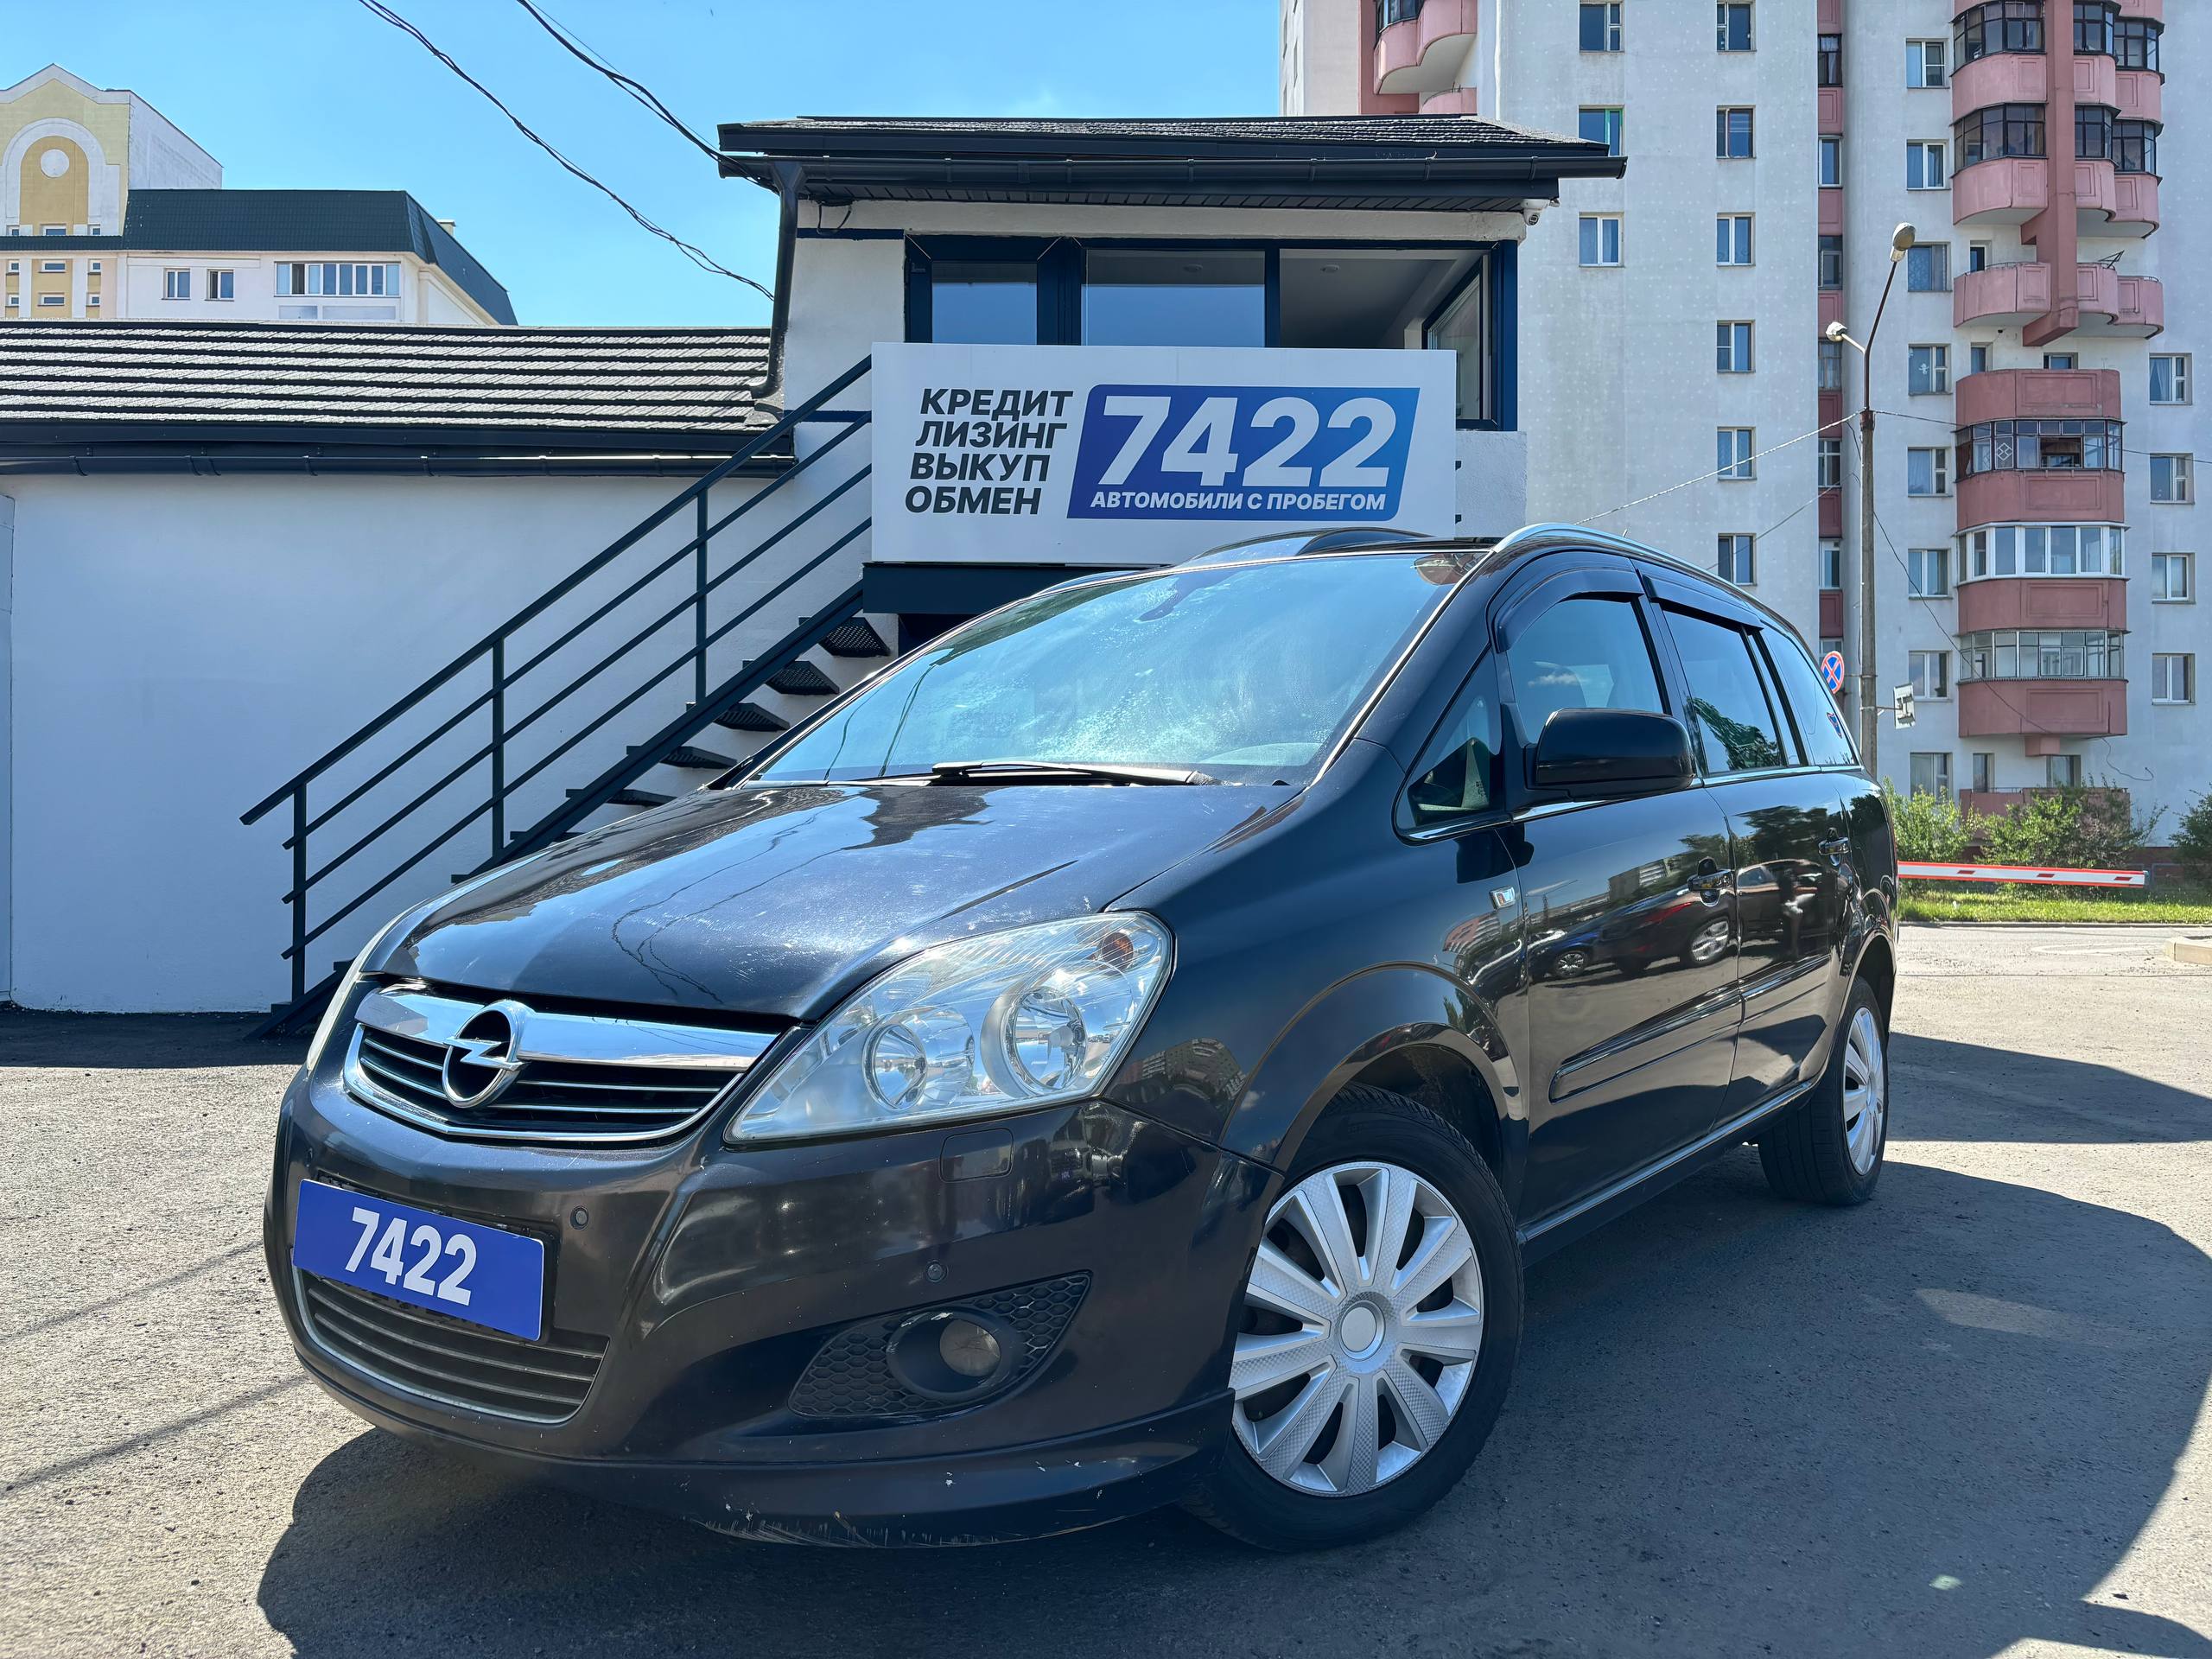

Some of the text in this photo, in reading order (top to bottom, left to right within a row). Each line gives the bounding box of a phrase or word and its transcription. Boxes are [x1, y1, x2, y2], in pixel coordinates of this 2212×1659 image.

[920, 388, 1073, 421] КРЕДИТ
[915, 421, 1067, 449] ЛИЗИНГ
[1097, 395, 1397, 487] 7422
[910, 453, 1050, 481] ВЫКУП
[905, 486, 1041, 514] ОБМЕН
[1090, 491, 1387, 511] АВТОМОБИЛИ С ПРОБЕГОМ
[345, 1206, 476, 1306] 7422
